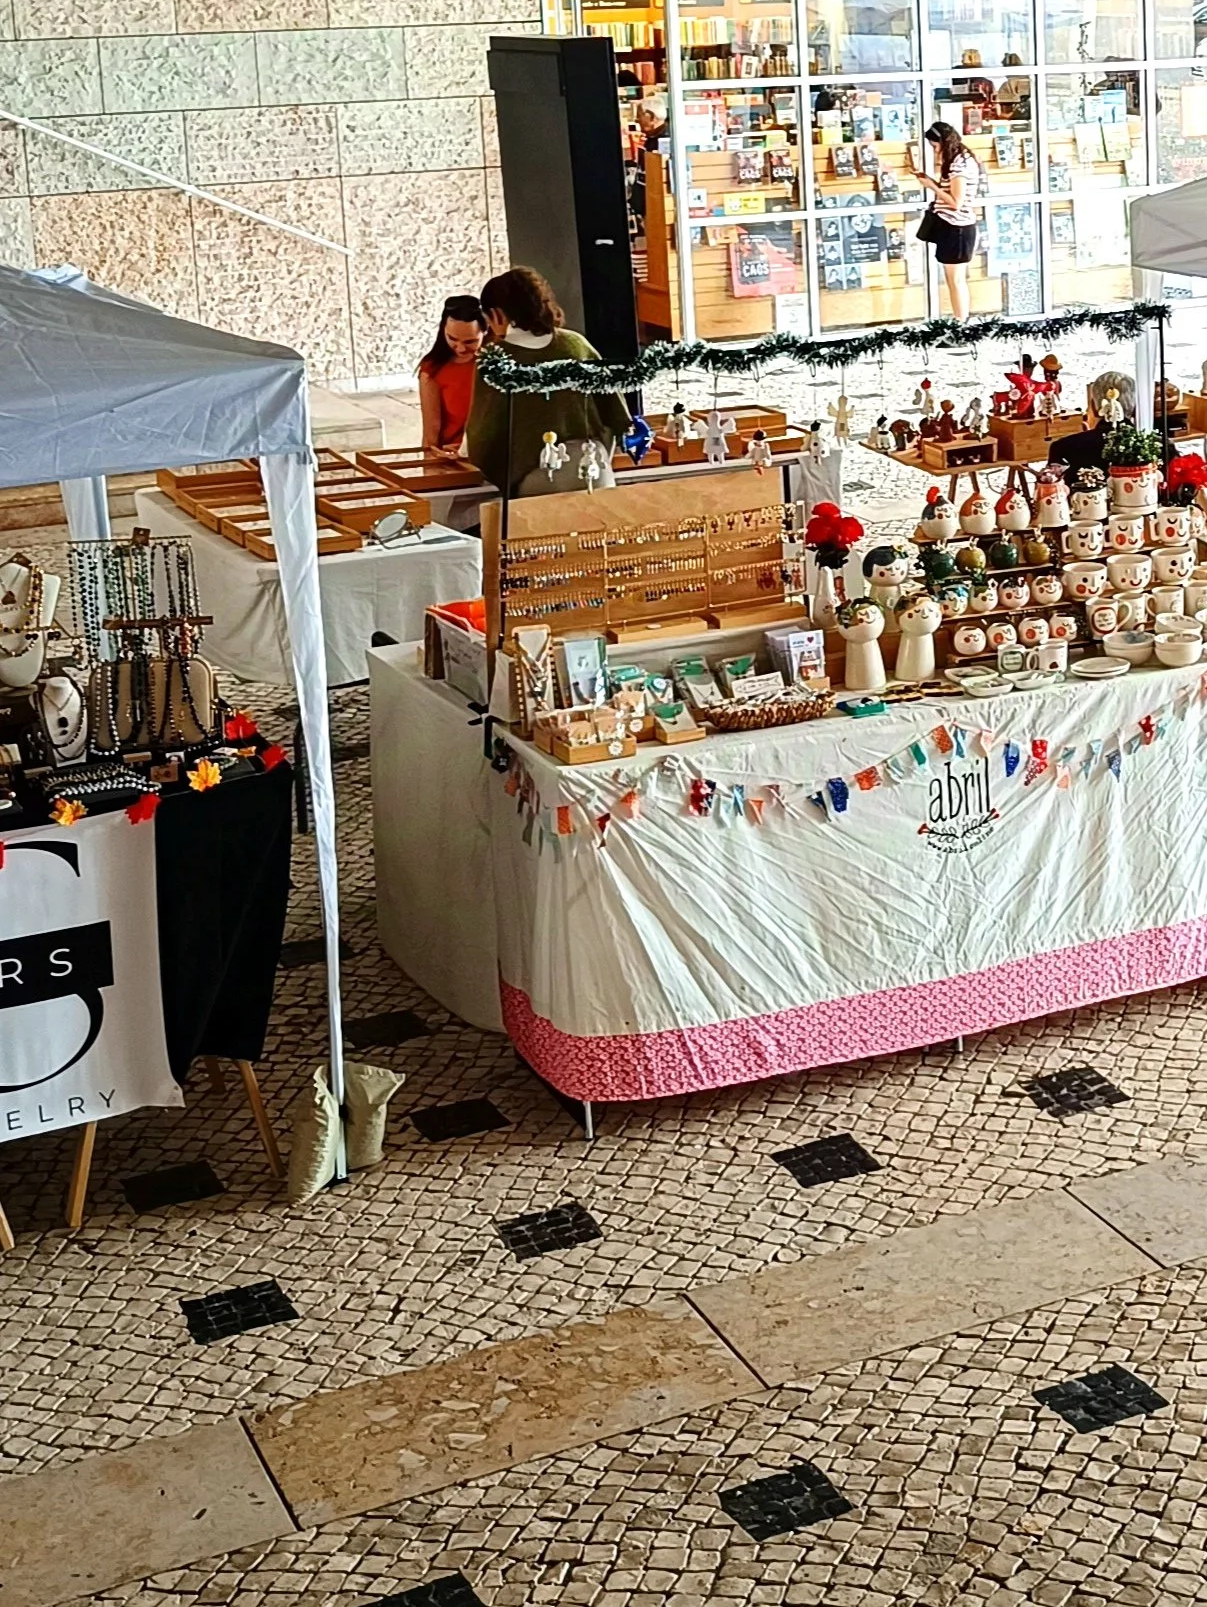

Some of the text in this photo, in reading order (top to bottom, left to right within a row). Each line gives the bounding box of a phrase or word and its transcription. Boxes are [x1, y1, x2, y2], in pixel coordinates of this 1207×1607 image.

[742, 263, 770, 278] CAOS
[929, 756, 990, 823] abril
[6, 1089, 115, 1131] ELRY
